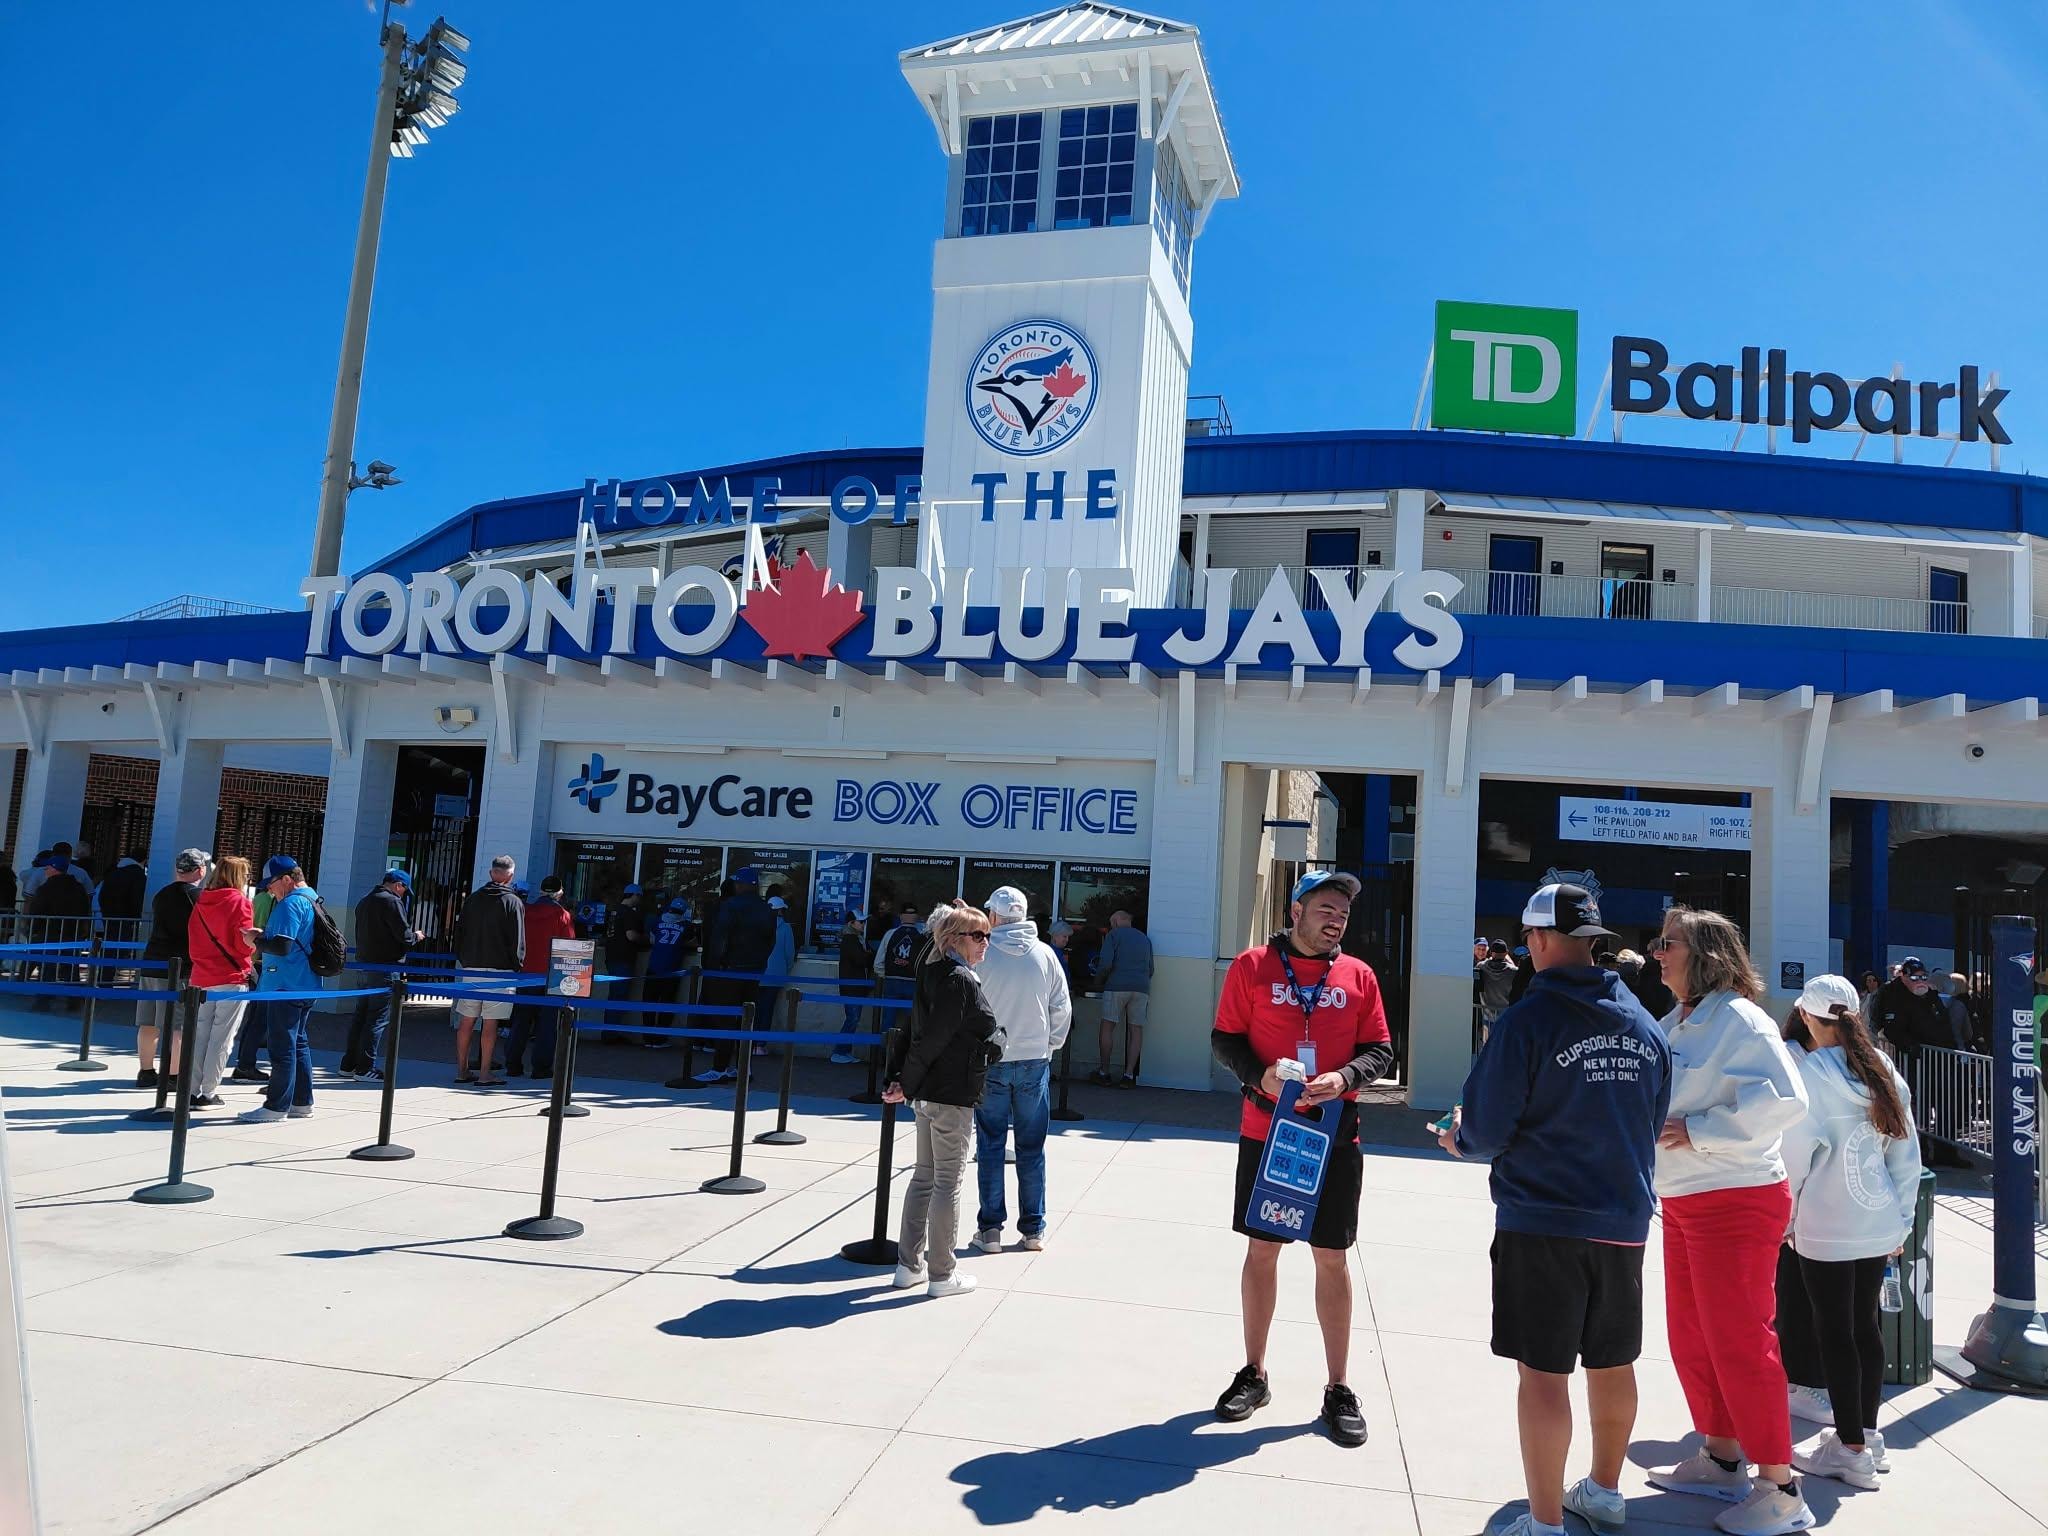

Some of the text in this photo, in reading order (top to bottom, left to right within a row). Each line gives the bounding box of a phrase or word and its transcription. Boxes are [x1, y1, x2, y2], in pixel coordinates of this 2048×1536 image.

[980, 330, 1062, 374] TORONTO
[1450, 329, 2013, 445] TD Ballpark
[976, 403, 1082, 447] BLUE JAYS
[580, 469, 1118, 525] HOME OF THE
[301, 563, 1465, 671] TORONTO BLUE JAYS
[626, 774, 813, 828] BayCare
[833, 779, 1137, 835] BOX OFFICE
[1594, 805, 1671, 818] 108-116, 208-212
[1593, 815, 1647, 827] THE PAVILION
[1592, 827, 1698, 843] LEFT FIELD PATIO AND BAR
[1709, 828, 1752, 840] RIGHT FIEL
[1070, 865, 1091, 873] MOBILE
[1092, 866, 1122, 874] TICKETING
[658, 930, 681, 945] 27
[1271, 983, 1347, 1009] 50 50
[1556, 1034, 1658, 1068] CUPSOGUE BEACH
[1583, 1057, 1641, 1071] NEW YORK
[1617, 1071, 1639, 1082] ONLY
[2012, 1008, 2035, 1156] BLUE JAYS
[1280, 1128, 1299, 1144] $75
[1304, 1136, 1323, 1152] $50
[1273, 1155, 1292, 1171] $25
[1298, 1163, 1316, 1179] $10
[1260, 1199, 1305, 1231] 50 50
